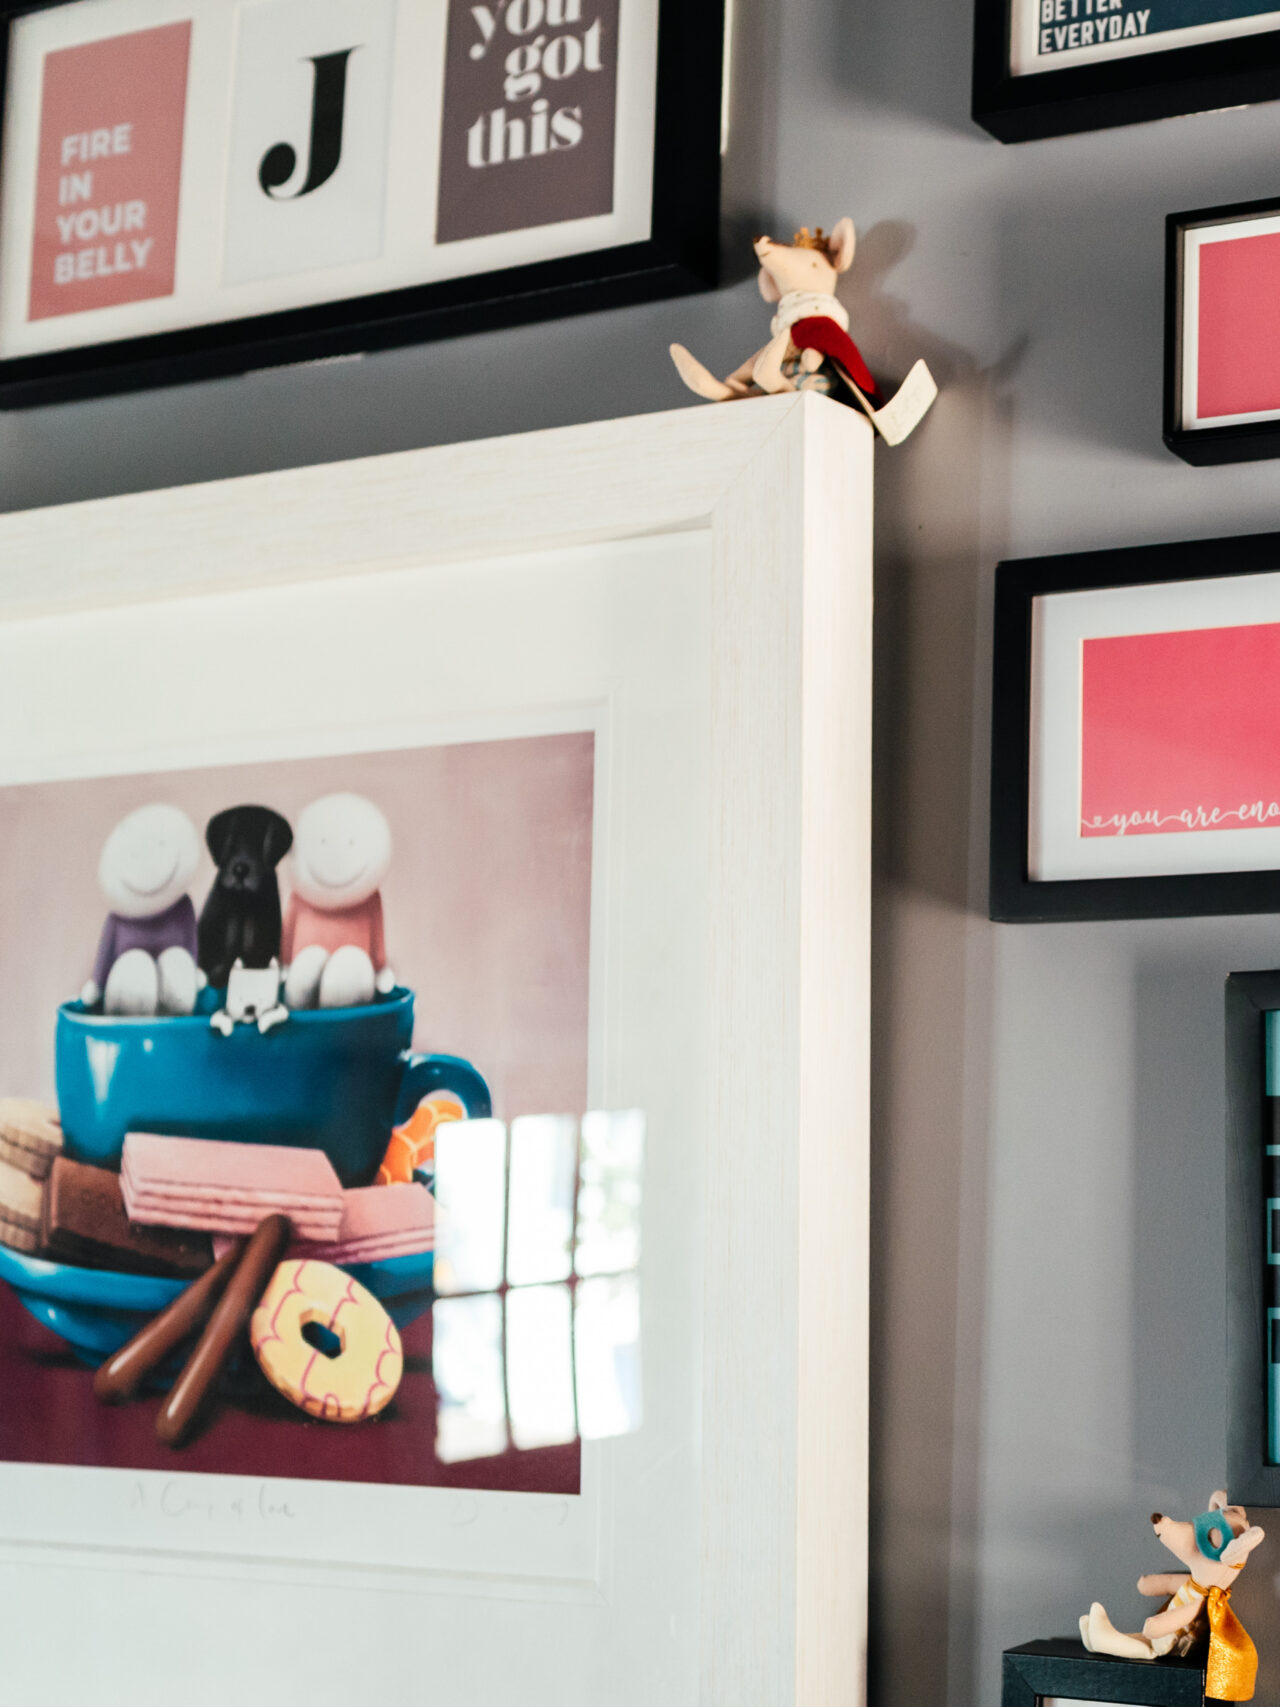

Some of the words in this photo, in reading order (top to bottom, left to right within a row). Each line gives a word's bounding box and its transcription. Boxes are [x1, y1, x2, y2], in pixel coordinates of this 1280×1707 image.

[469, 0, 582, 60] you
[1041, 9, 1150, 53] EVERYDAY
[503, 16, 603, 102] got
[61, 122, 133, 166] FIRE
[258, 43, 367, 200] J
[466, 98, 583, 168] this
[58, 171, 93, 206] IN
[56, 199, 146, 244] YOUR
[53, 237, 154, 284] BELLY
[1109, 809, 1160, 836] you
[1178, 804, 1221, 828] are
